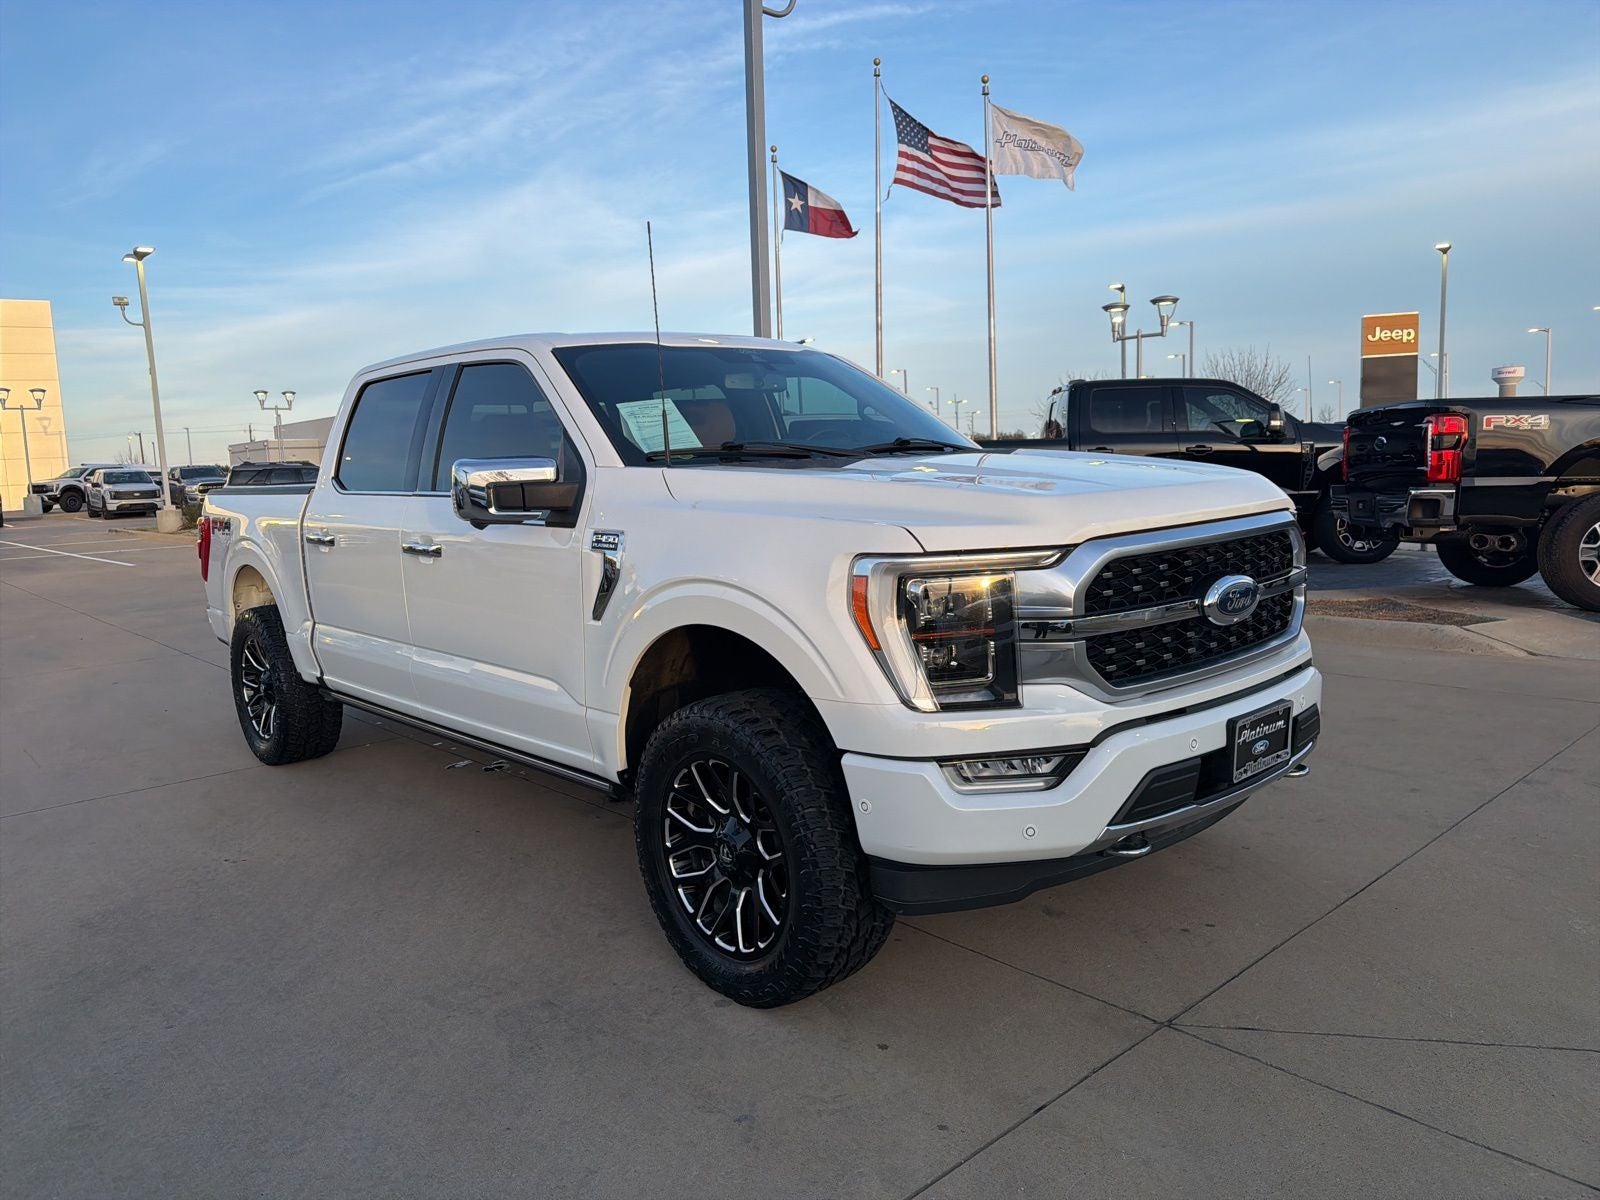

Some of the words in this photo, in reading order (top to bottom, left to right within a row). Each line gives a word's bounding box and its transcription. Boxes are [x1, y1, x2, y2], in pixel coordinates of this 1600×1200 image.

[1367, 326, 1416, 343] Jeep
[1482, 415, 1550, 431] FX4
[1237, 720, 1287, 746] Platinum
